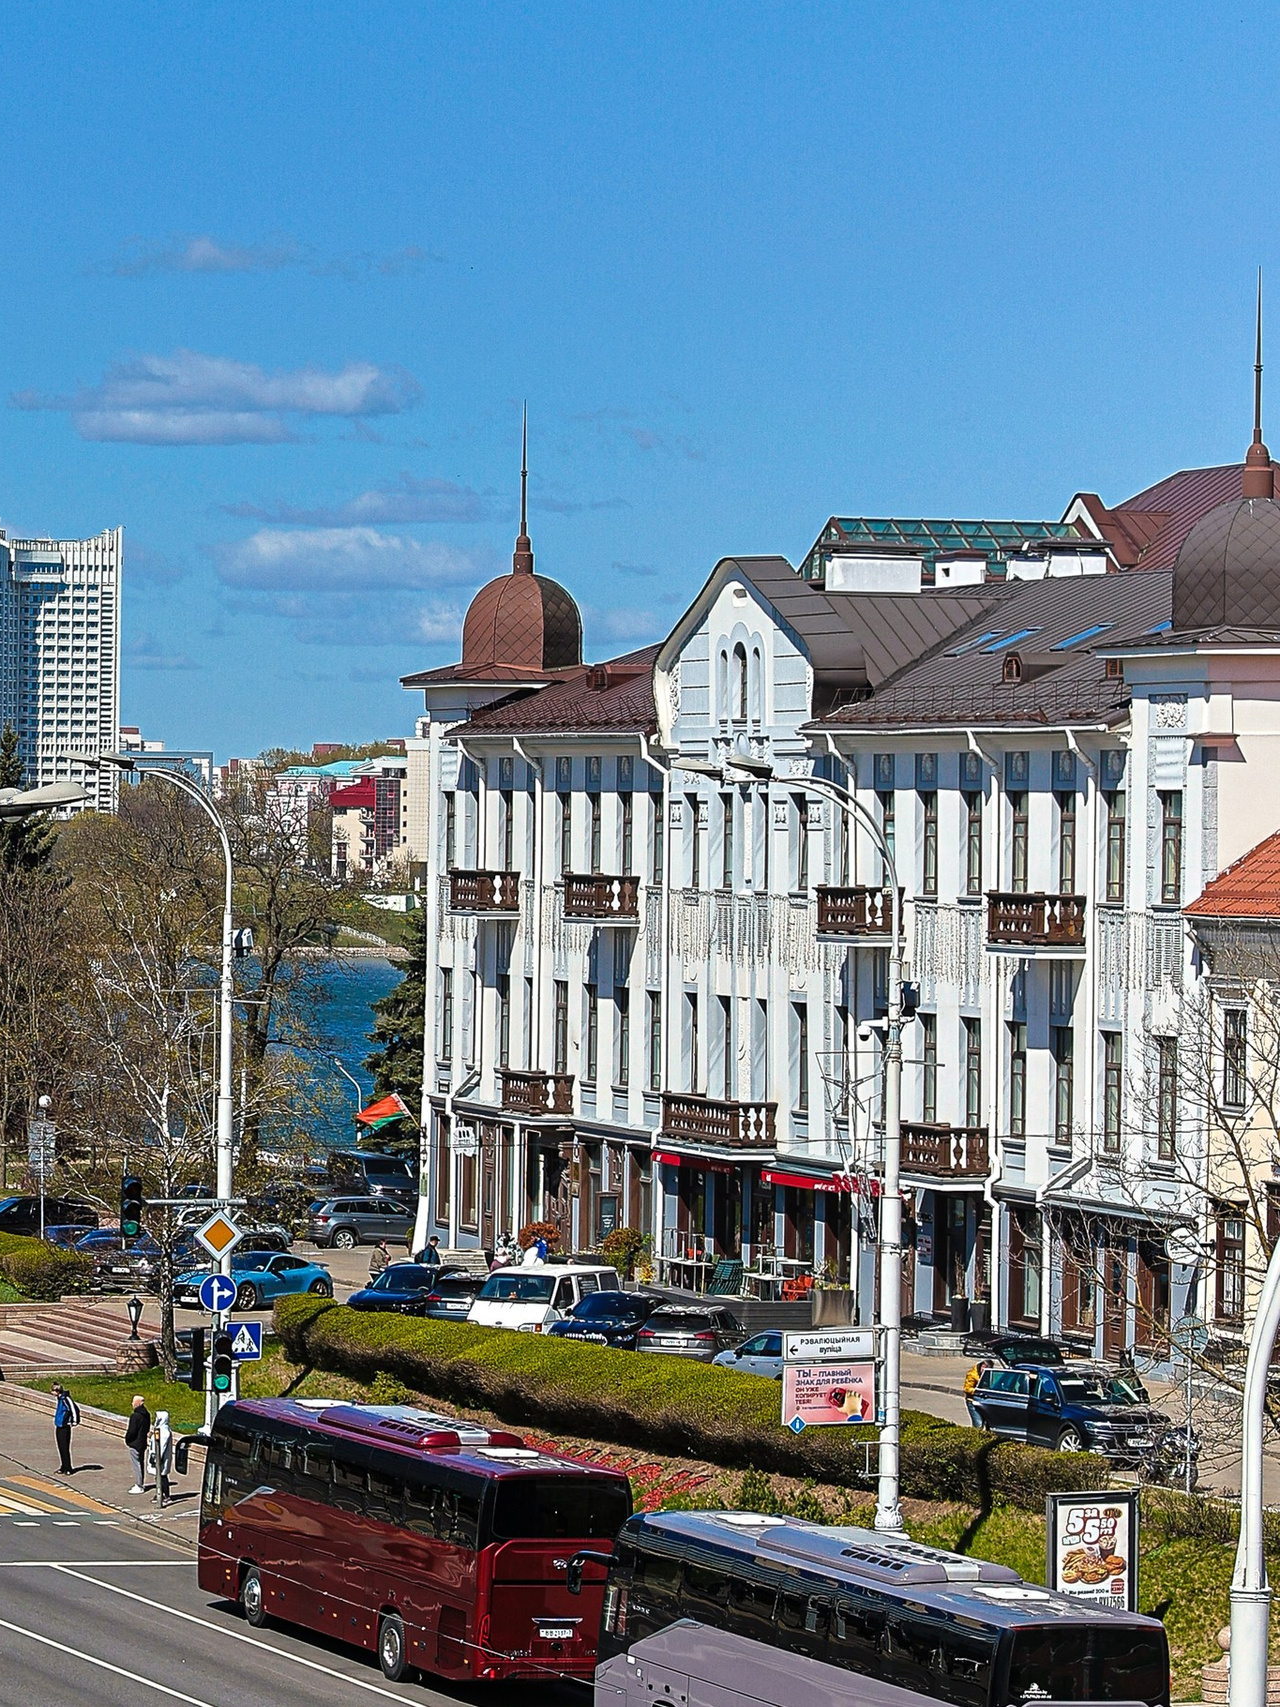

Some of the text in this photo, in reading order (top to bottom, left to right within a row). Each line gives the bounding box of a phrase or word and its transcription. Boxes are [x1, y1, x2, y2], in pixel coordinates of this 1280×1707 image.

[800, 1336, 860, 1345] РЭВАЛЮЦЫЙНАЯ
[795, 1369, 811, 1378] ТЫ
[819, 1369, 851, 1377] ГЛАВНЫЙ
[831, 1377, 863, 1385] РЕБЁНКА
